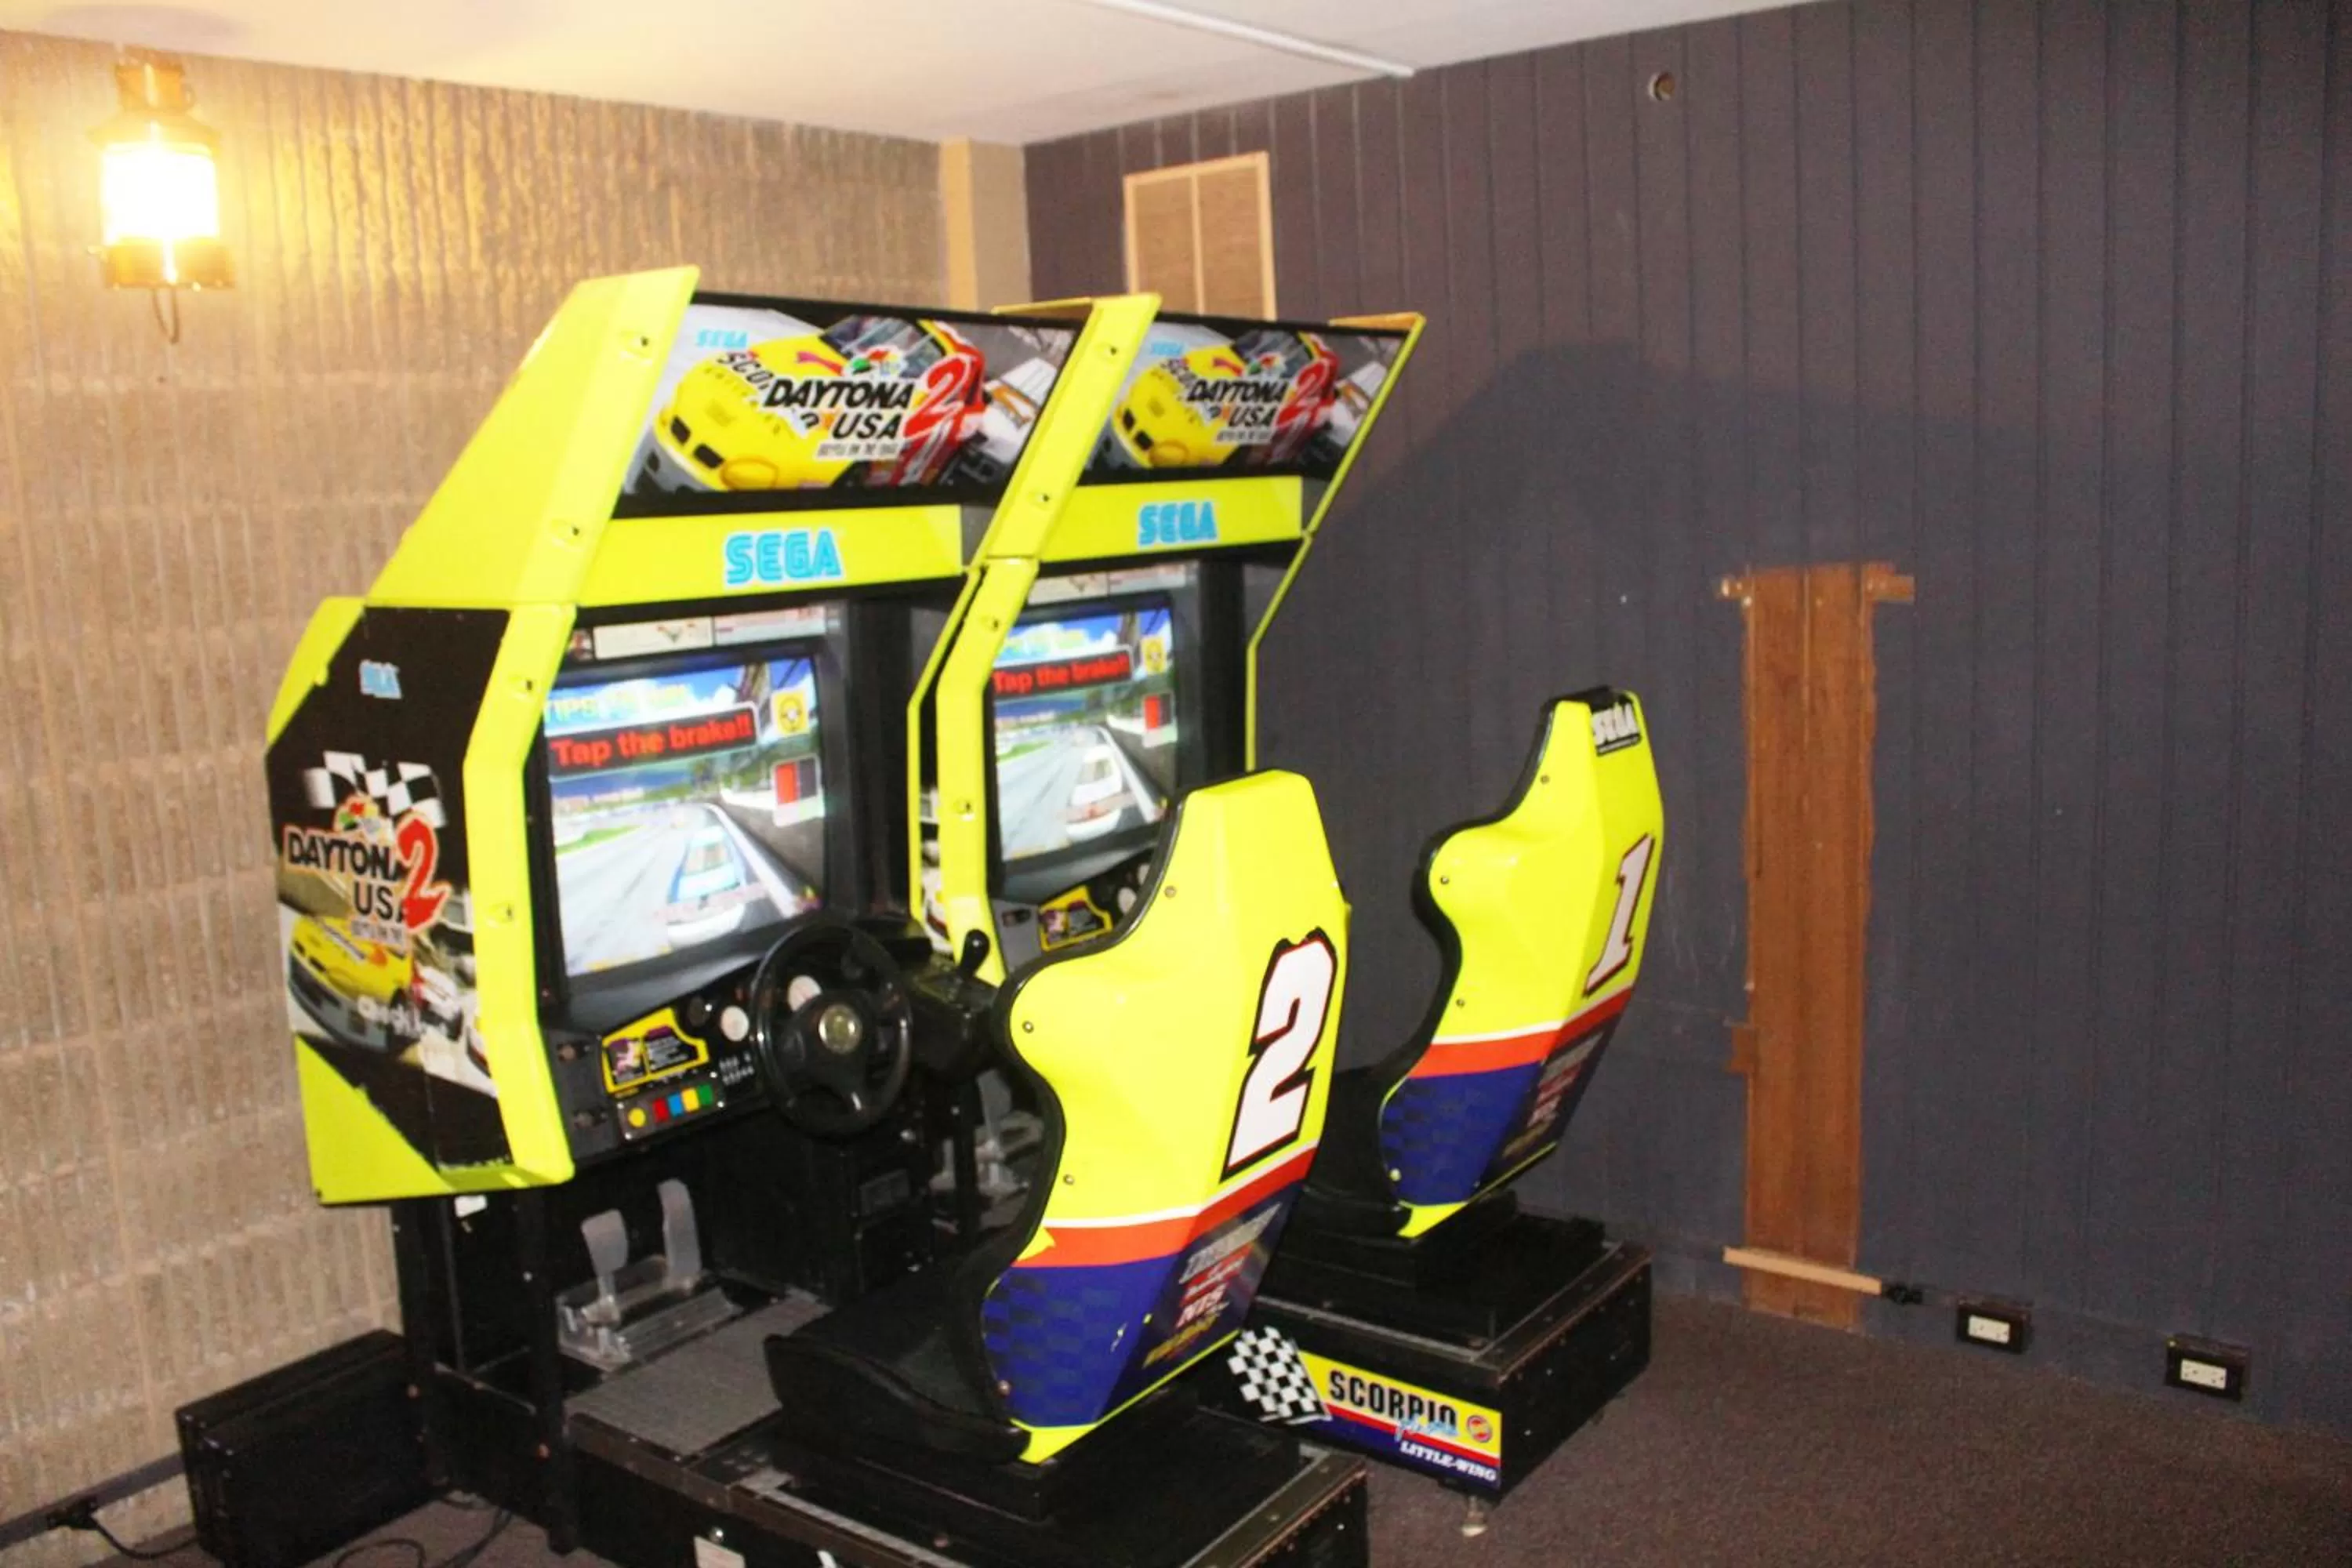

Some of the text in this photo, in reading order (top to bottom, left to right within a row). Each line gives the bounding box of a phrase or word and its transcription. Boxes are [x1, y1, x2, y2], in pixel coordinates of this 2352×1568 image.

[763, 353, 971, 438] DAYTONA 2
[1185, 358, 1331, 429] DAYTONA 2
[1228, 405, 1279, 428] USA
[833, 412, 903, 440] USA
[1139, 502, 1217, 546] SEGA
[724, 529, 841, 585] SEGA
[550, 714, 753, 767] Tap the brake!!
[397, 818, 445, 929] 2
[1583, 833, 1655, 998] 1
[1220, 927, 1338, 1183] 2
[1330, 1370, 1457, 1430] SCORPIO
[1400, 1441, 1497, 1481] LITTLE-WING
